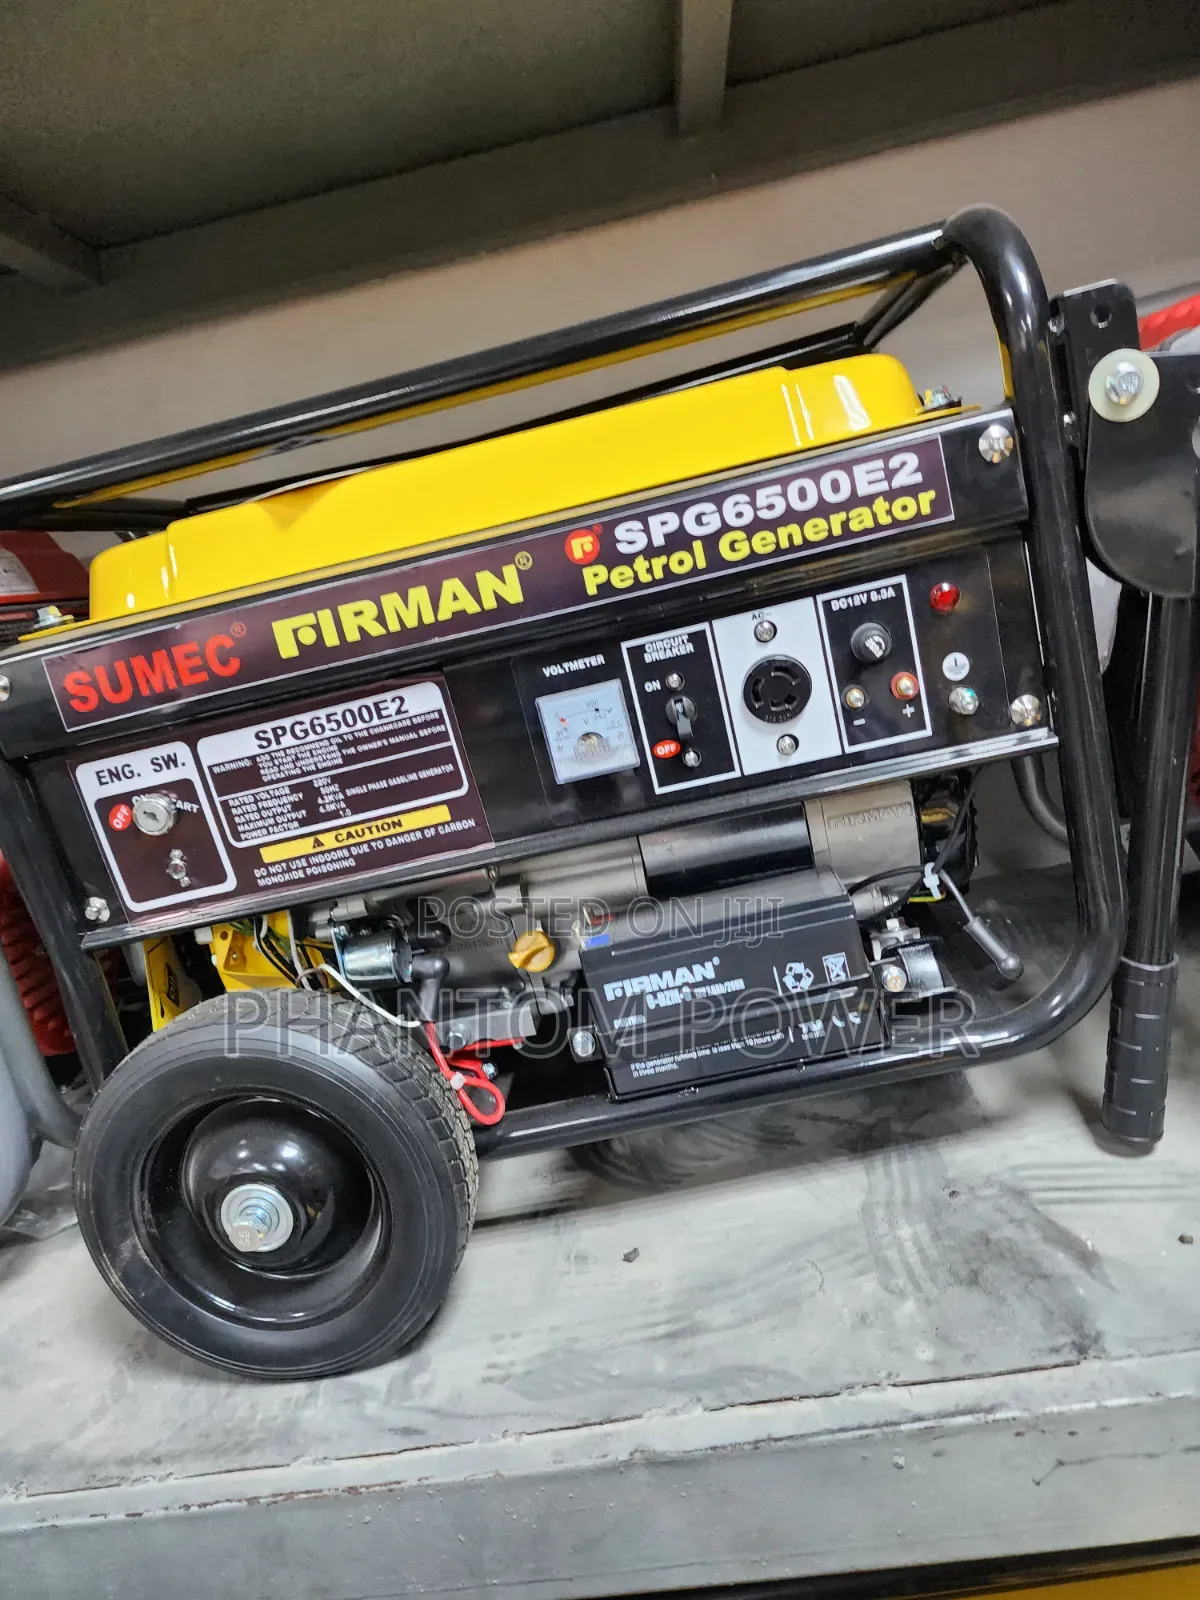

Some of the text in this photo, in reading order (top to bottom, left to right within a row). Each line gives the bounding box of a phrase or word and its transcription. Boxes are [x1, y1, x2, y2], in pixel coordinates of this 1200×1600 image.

[614, 452, 923, 554] SPG6500E2
[582, 489, 936, 596] Petrol Generator
[643, 642, 695, 664] BREAKER
[644, 634, 689, 653] CIRCUIT
[542, 654, 606, 677] VOLTMETER
[644, 679, 661, 693] ON
[254, 695, 409, 749] SPG6500E2
[212, 759, 253, 774] WARNING:
[343, 732, 353, 742] TO
[354, 728, 369, 739] THE
[413, 711, 440, 725] BEFORE
[342, 746, 357, 757] THE
[357, 739, 389, 753] OWNER'S
[388, 731, 418, 745] MANUAL
[419, 724, 446, 738] BEFORE
[656, 743, 677, 756] OFF
[95, 752, 186, 787] ENG. SW.
[345, 763, 455, 797] SINGLE PHASE GASOLINE GENERATOR
[228, 786, 290, 807] RATED VOLTAGE
[231, 792, 304, 816] RATED FREQUENCY
[112, 804, 130, 829] OFF
[234, 804, 292, 824] RATED OUTPUT
[237, 809, 307, 833] MAXIMUM OUTPUT
[240, 821, 300, 841] POWER FACTOR
[334, 819, 403, 843] CAUTION
[253, 817, 476, 878] DO NOT USE INDOORS DUE TO DANGER OF CARBON
[256, 857, 356, 887] MONOXIDE POISONING
